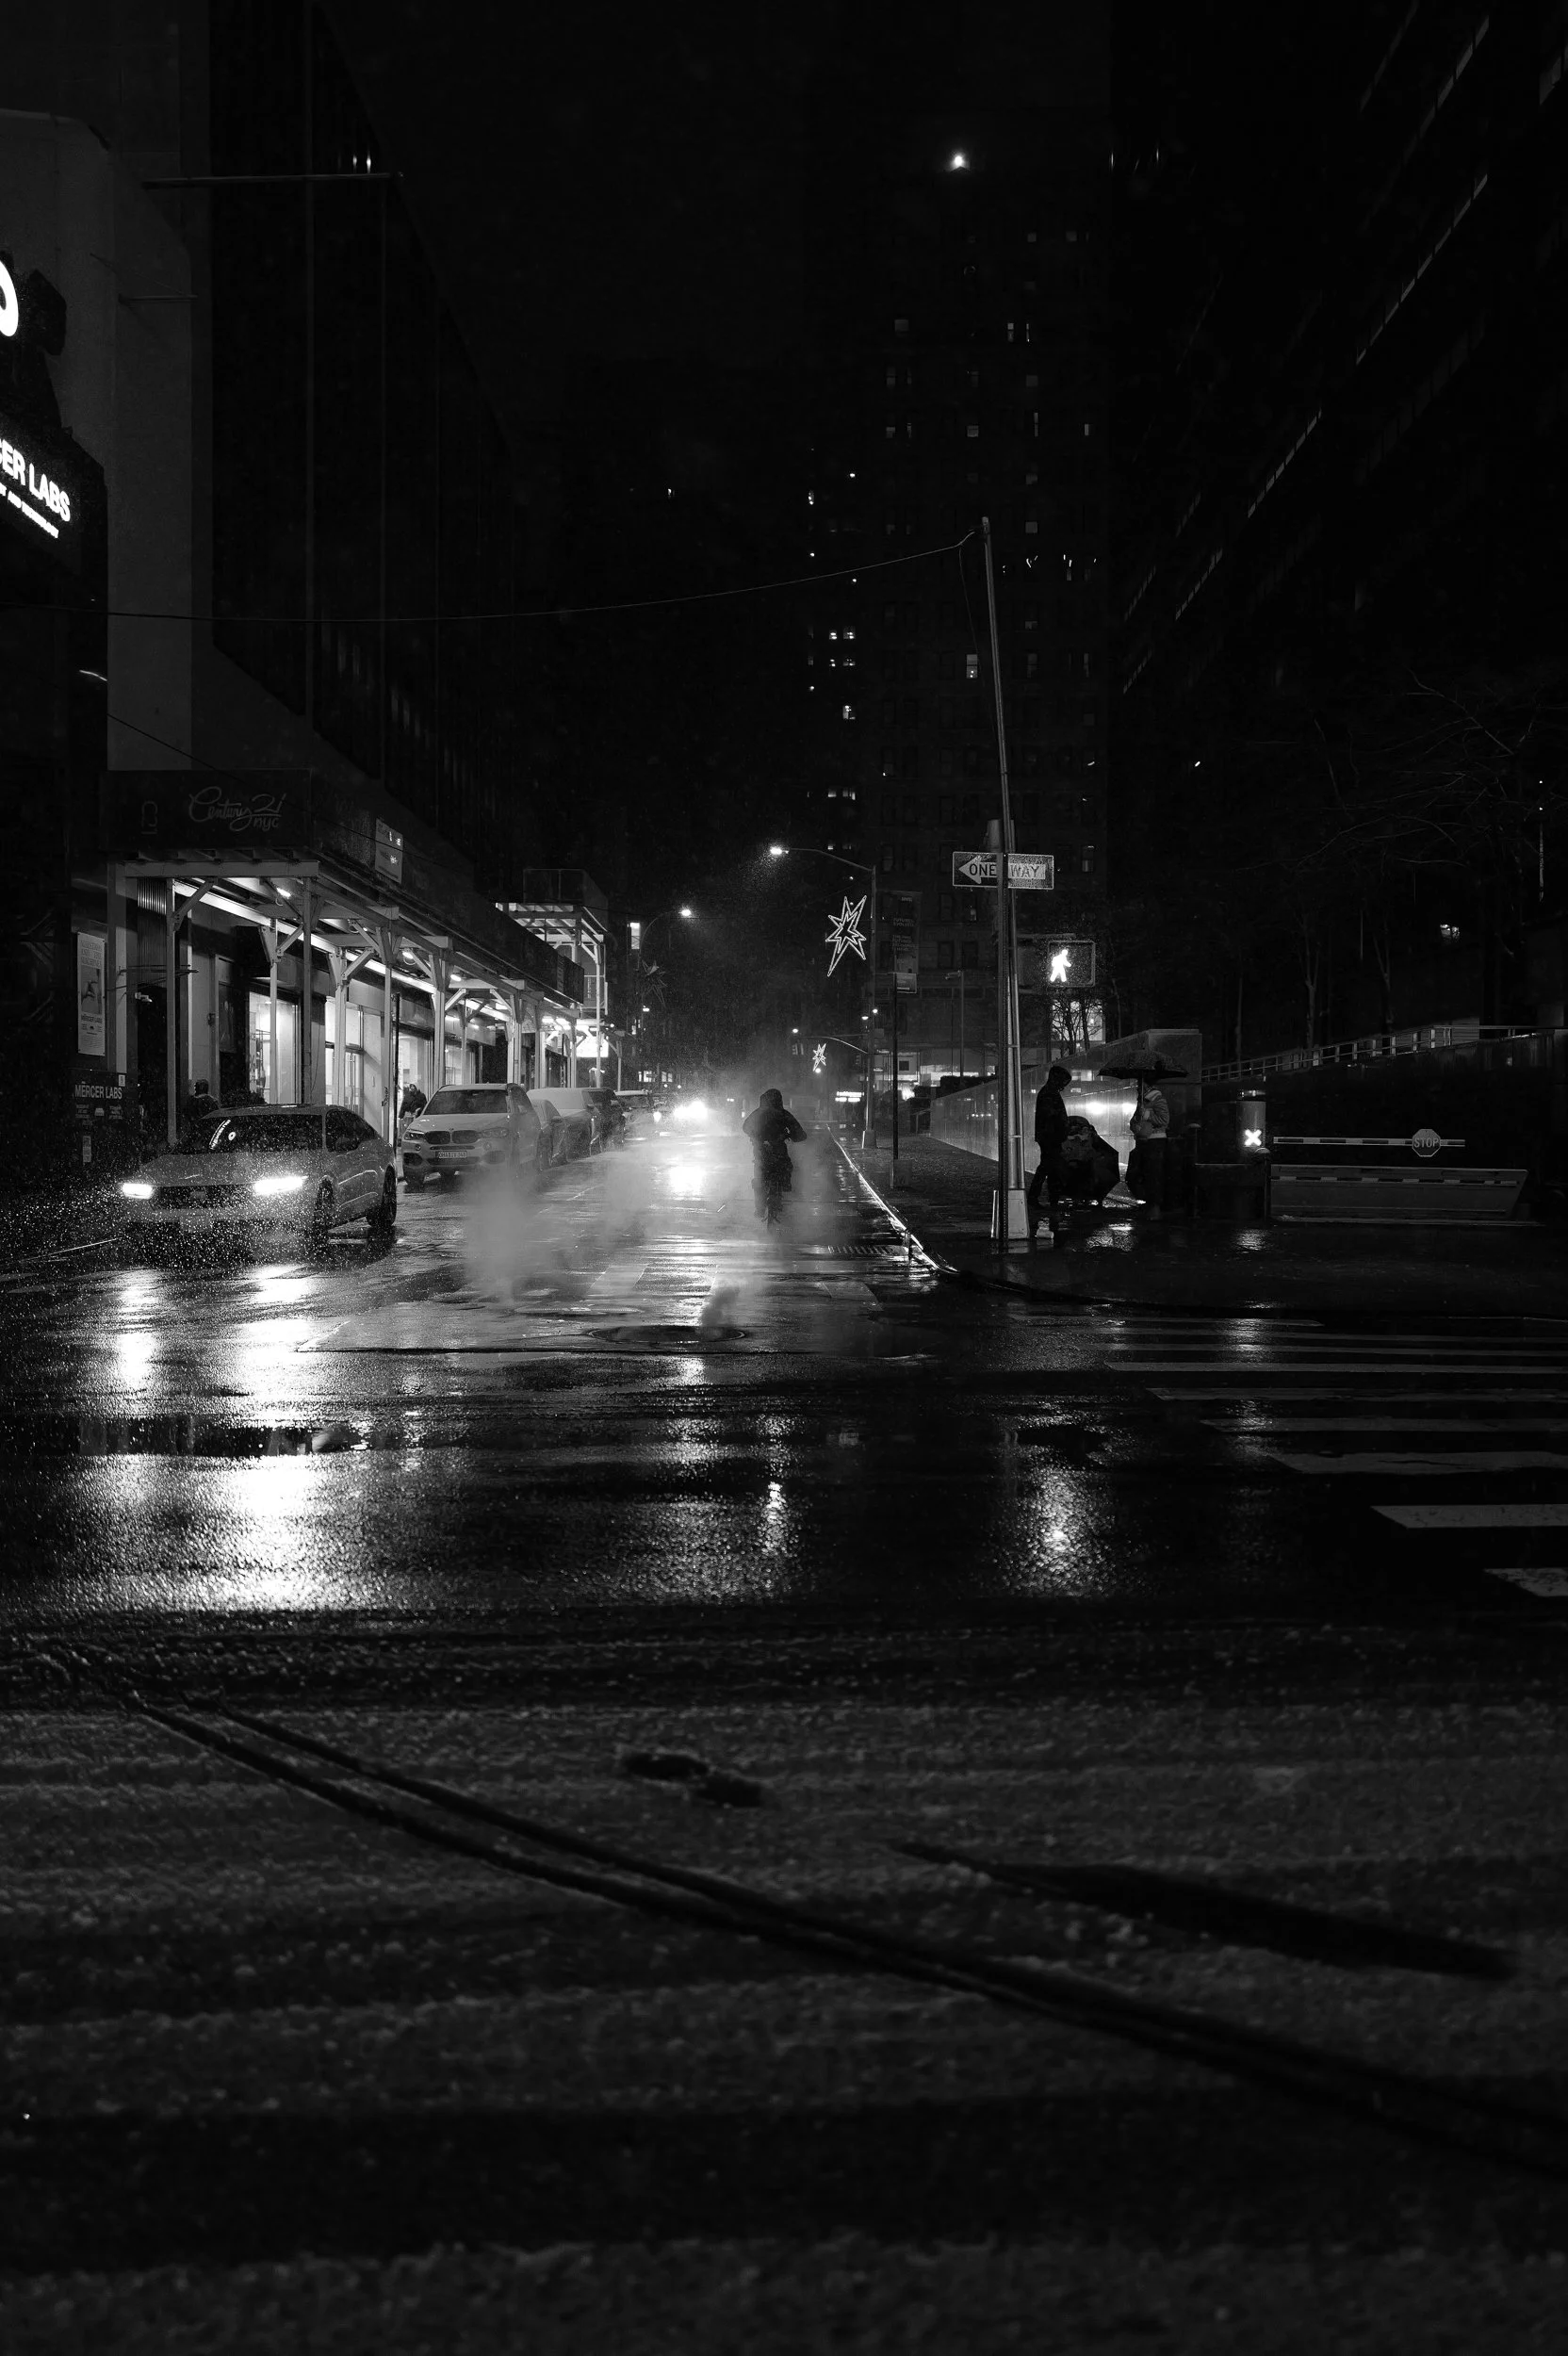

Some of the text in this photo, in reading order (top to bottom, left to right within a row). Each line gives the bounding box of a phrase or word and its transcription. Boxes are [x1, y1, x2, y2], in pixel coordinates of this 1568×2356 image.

[29, 463, 71, 522] LABS
[188, 785, 288, 832] Century 21
[253, 815, 280, 832] nyc
[969, 863, 1040, 878] ONE WAY
[74, 1084, 122, 1100] MERCER LABS
[1413, 1137, 1439, 1148] STOP
